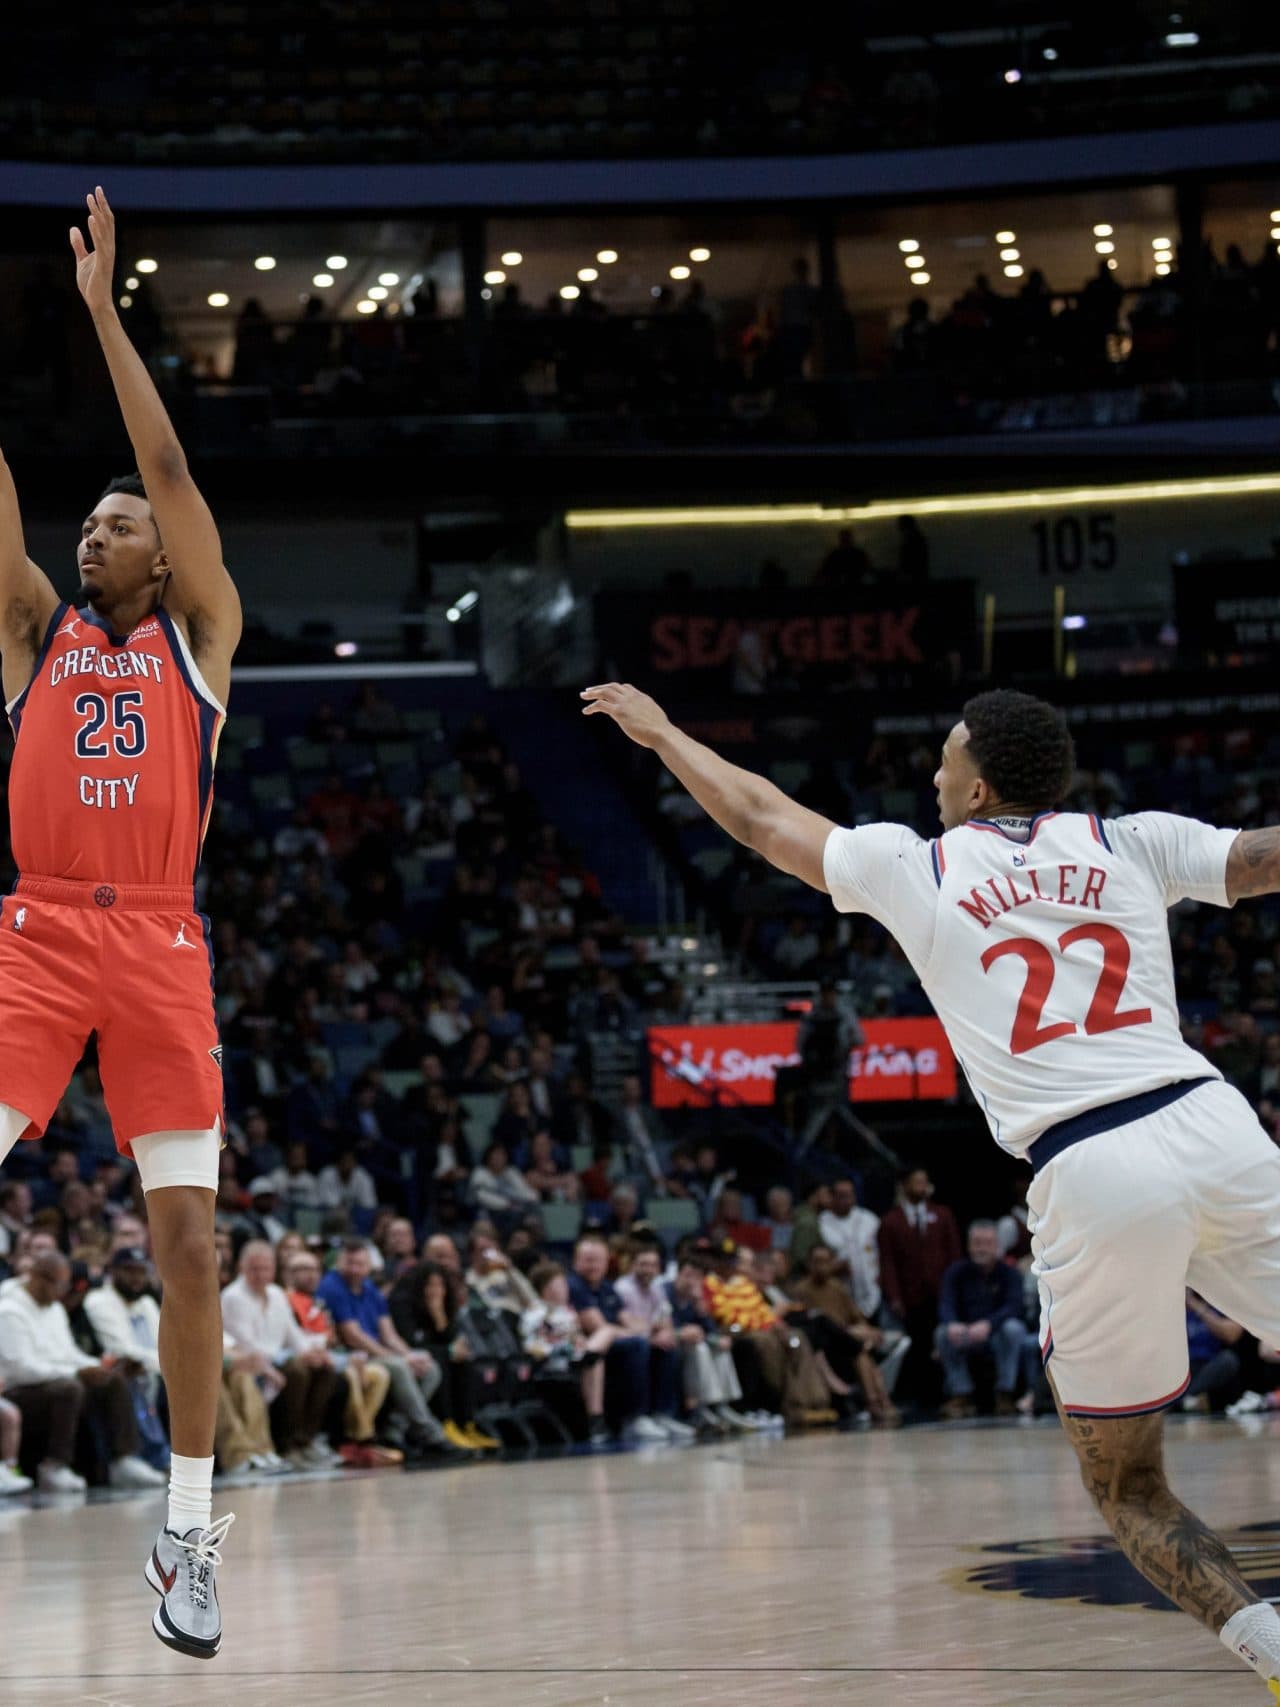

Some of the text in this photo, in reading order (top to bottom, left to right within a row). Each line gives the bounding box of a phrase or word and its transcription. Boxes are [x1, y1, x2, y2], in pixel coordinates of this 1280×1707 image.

[1031, 513, 1116, 574] 105
[650, 604, 924, 672] SEATGEEK
[74, 690, 147, 758] 25
[79, 772, 141, 810] CITY
[995, 818, 1018, 828] NIKE
[957, 864, 1108, 929] MILLER
[980, 922, 1153, 1055] 22
